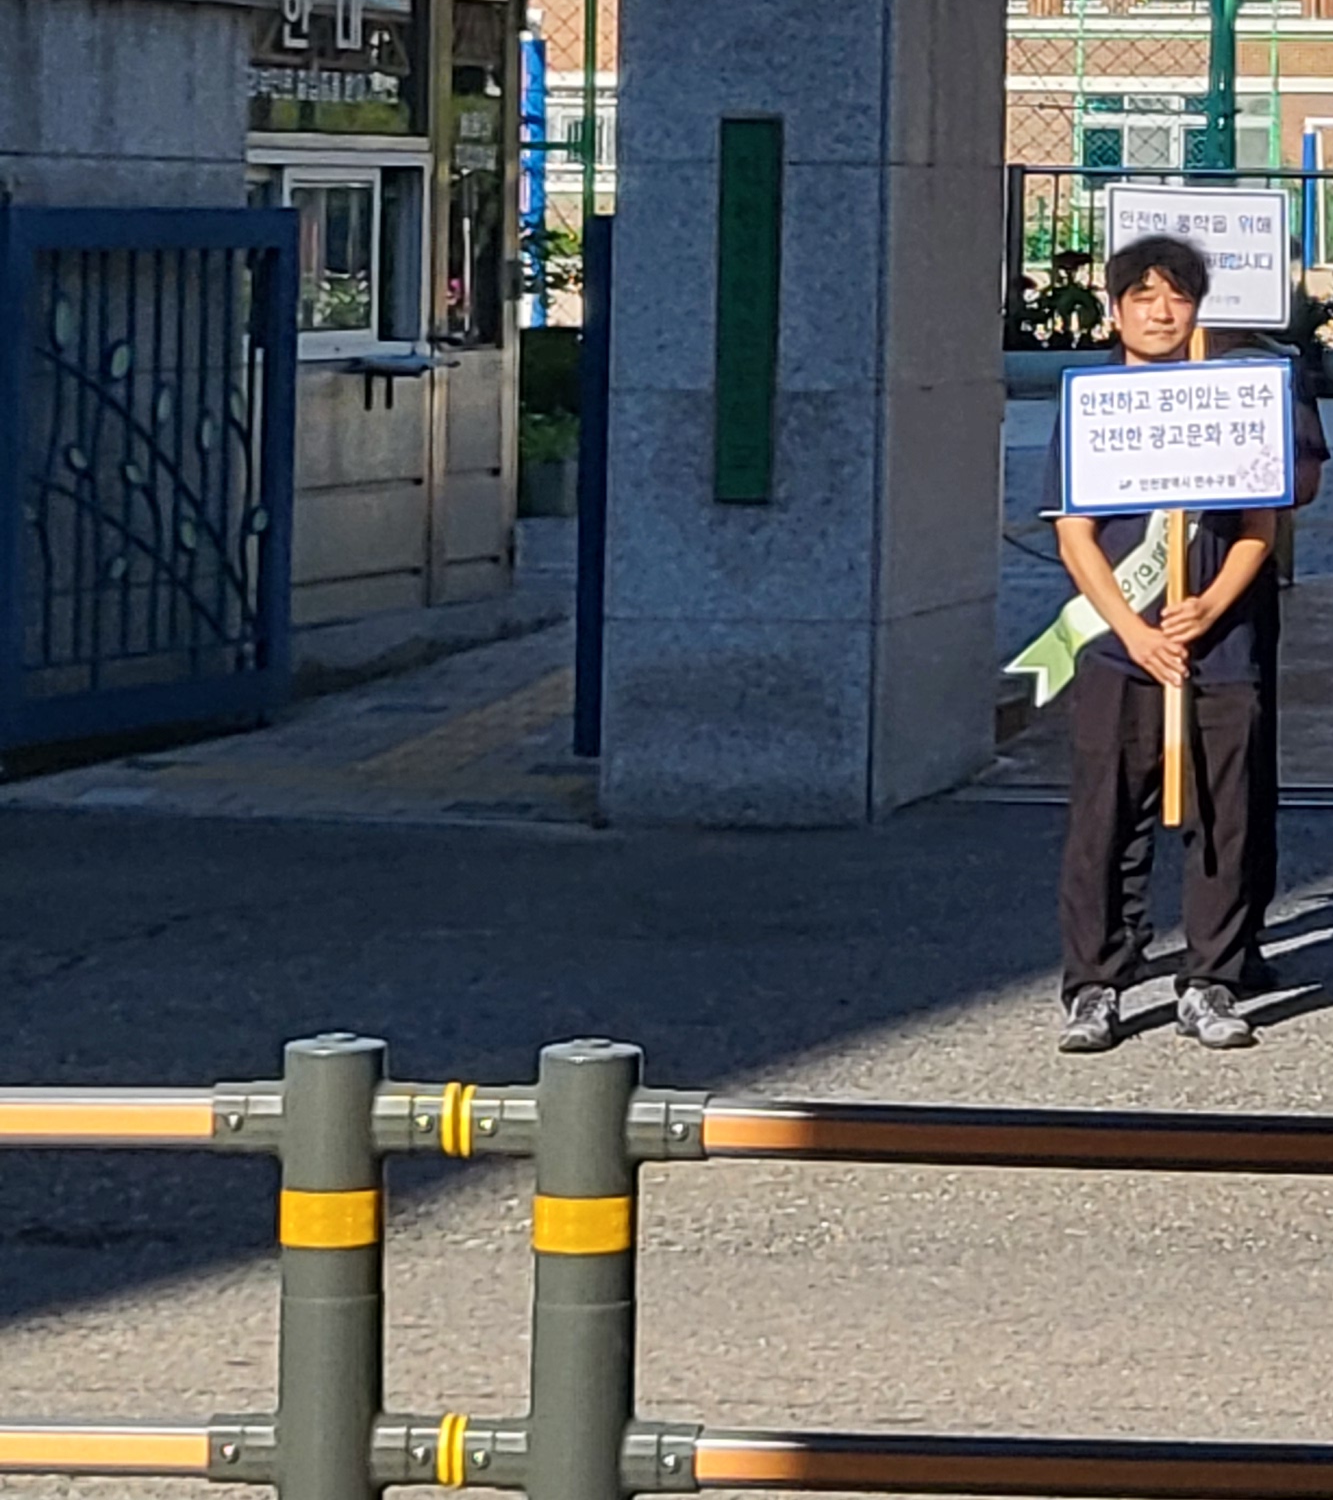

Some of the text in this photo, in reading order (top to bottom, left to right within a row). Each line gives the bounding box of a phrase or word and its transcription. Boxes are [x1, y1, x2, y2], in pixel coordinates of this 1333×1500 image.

[1079, 383, 1275, 416] 안전하고 꿈이있는 연수
[1088, 419, 1266, 453] 건전한 광고문화 정착
